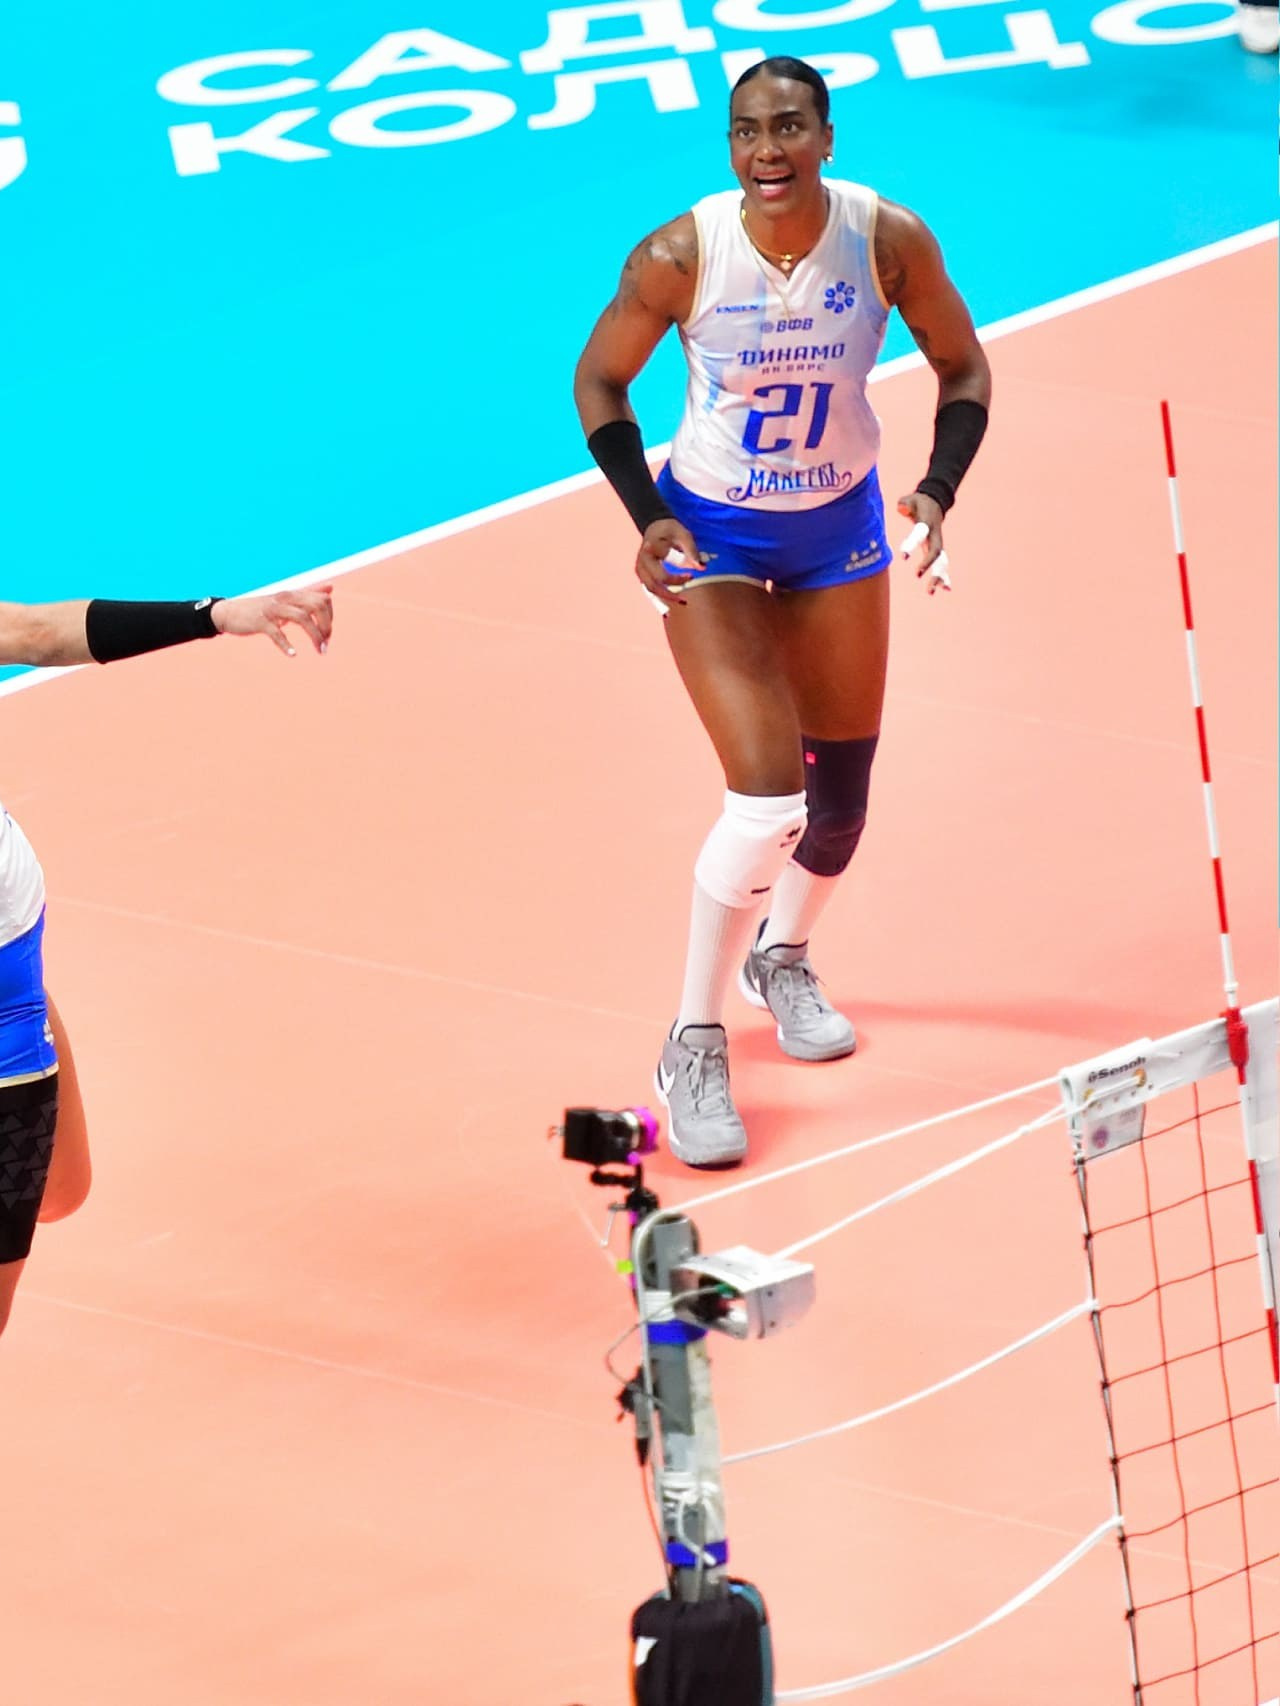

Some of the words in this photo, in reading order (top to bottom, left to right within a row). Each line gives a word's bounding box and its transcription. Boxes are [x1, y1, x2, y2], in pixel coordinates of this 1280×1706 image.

[775, 317, 814, 333] ВФВ
[737, 343, 846, 367] ДИНАМО
[742, 382, 835, 456] 21
